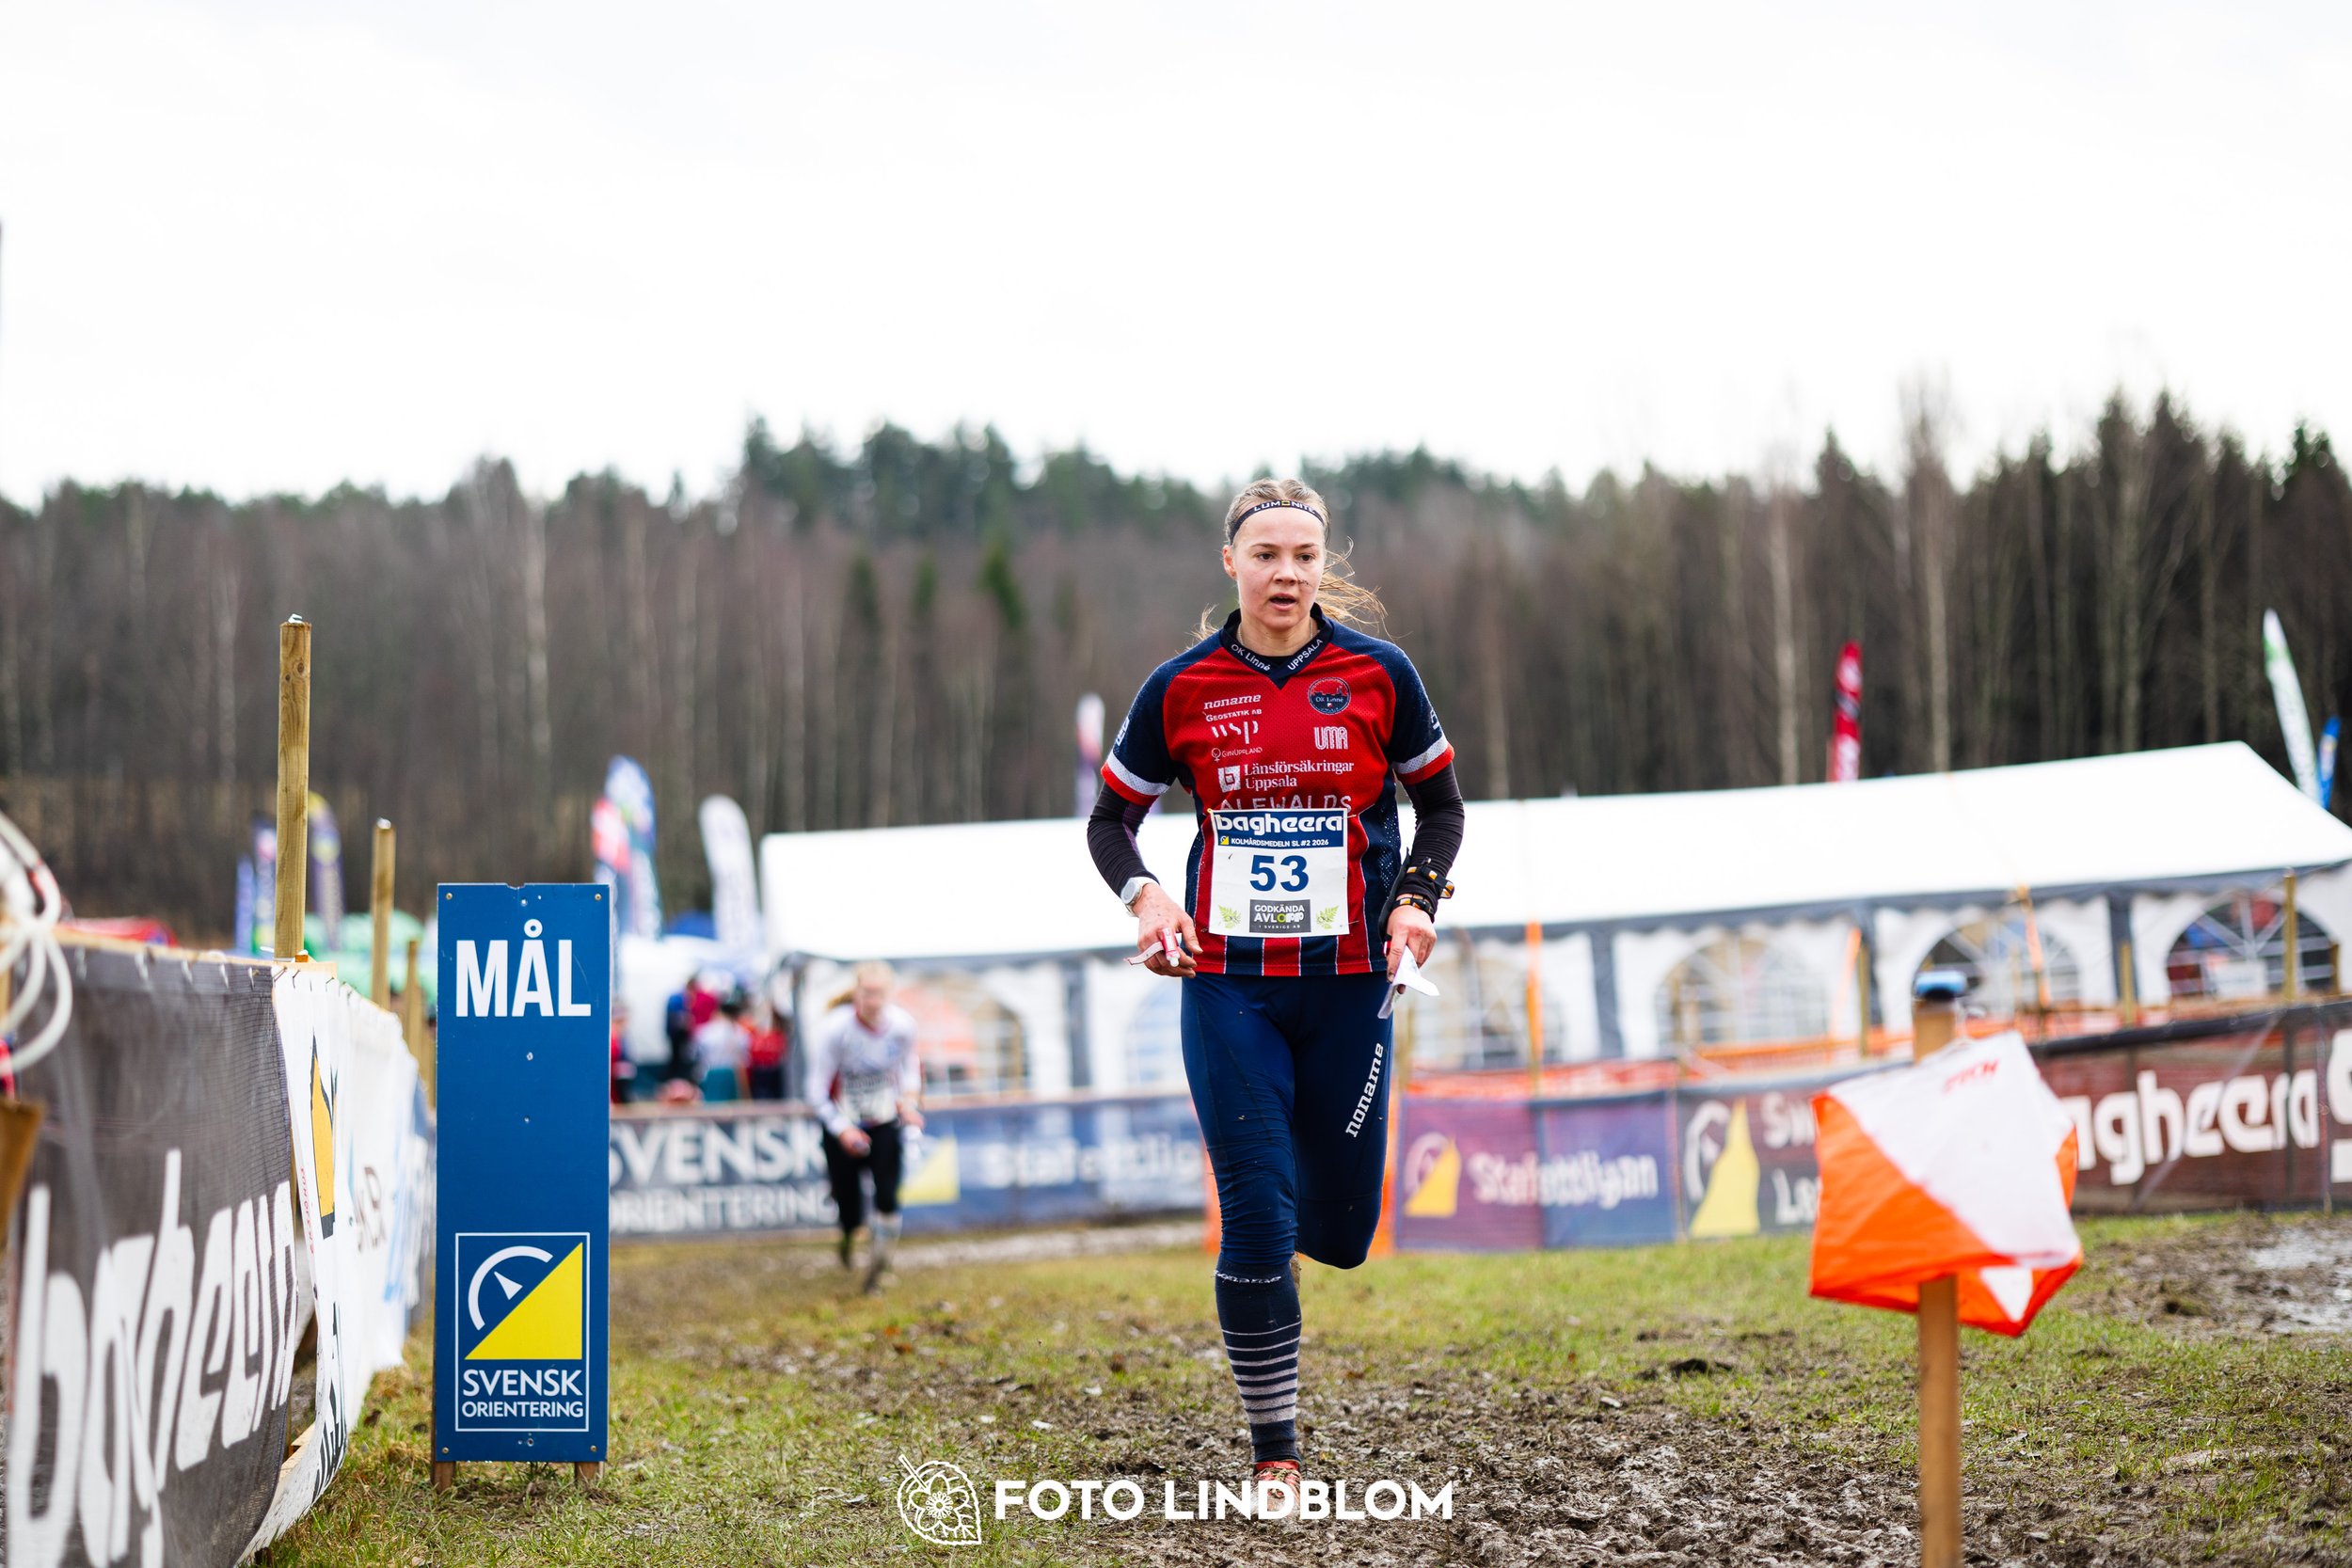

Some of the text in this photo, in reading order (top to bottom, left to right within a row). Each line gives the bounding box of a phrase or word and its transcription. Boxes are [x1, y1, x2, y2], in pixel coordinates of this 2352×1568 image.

[1231, 643, 1271, 672] OK Linné
[1287, 639, 1323, 671] UPPSALA
[1204, 694, 1262, 709] noname
[1313, 726, 1349, 750] UMA
[1244, 760, 1355, 776] Länsförsäkringar
[1245, 775, 1297, 792] Uppsala
[1216, 814, 1343, 835] bagheera
[1231, 837, 1290, 847] KOLMÅRDSMEDELN
[1249, 854, 1310, 892] 53
[1254, 904, 1305, 913] GODKÄNDA
[455, 918, 592, 1017] MÅL
[1345, 1042, 1384, 1138] noname
[2058, 1070, 2320, 1185] agheera
[610, 1182, 841, 1234] RIENTERING
[463, 1369, 583, 1397] SVENSK
[461, 1401, 584, 1418] ORIENTERING
